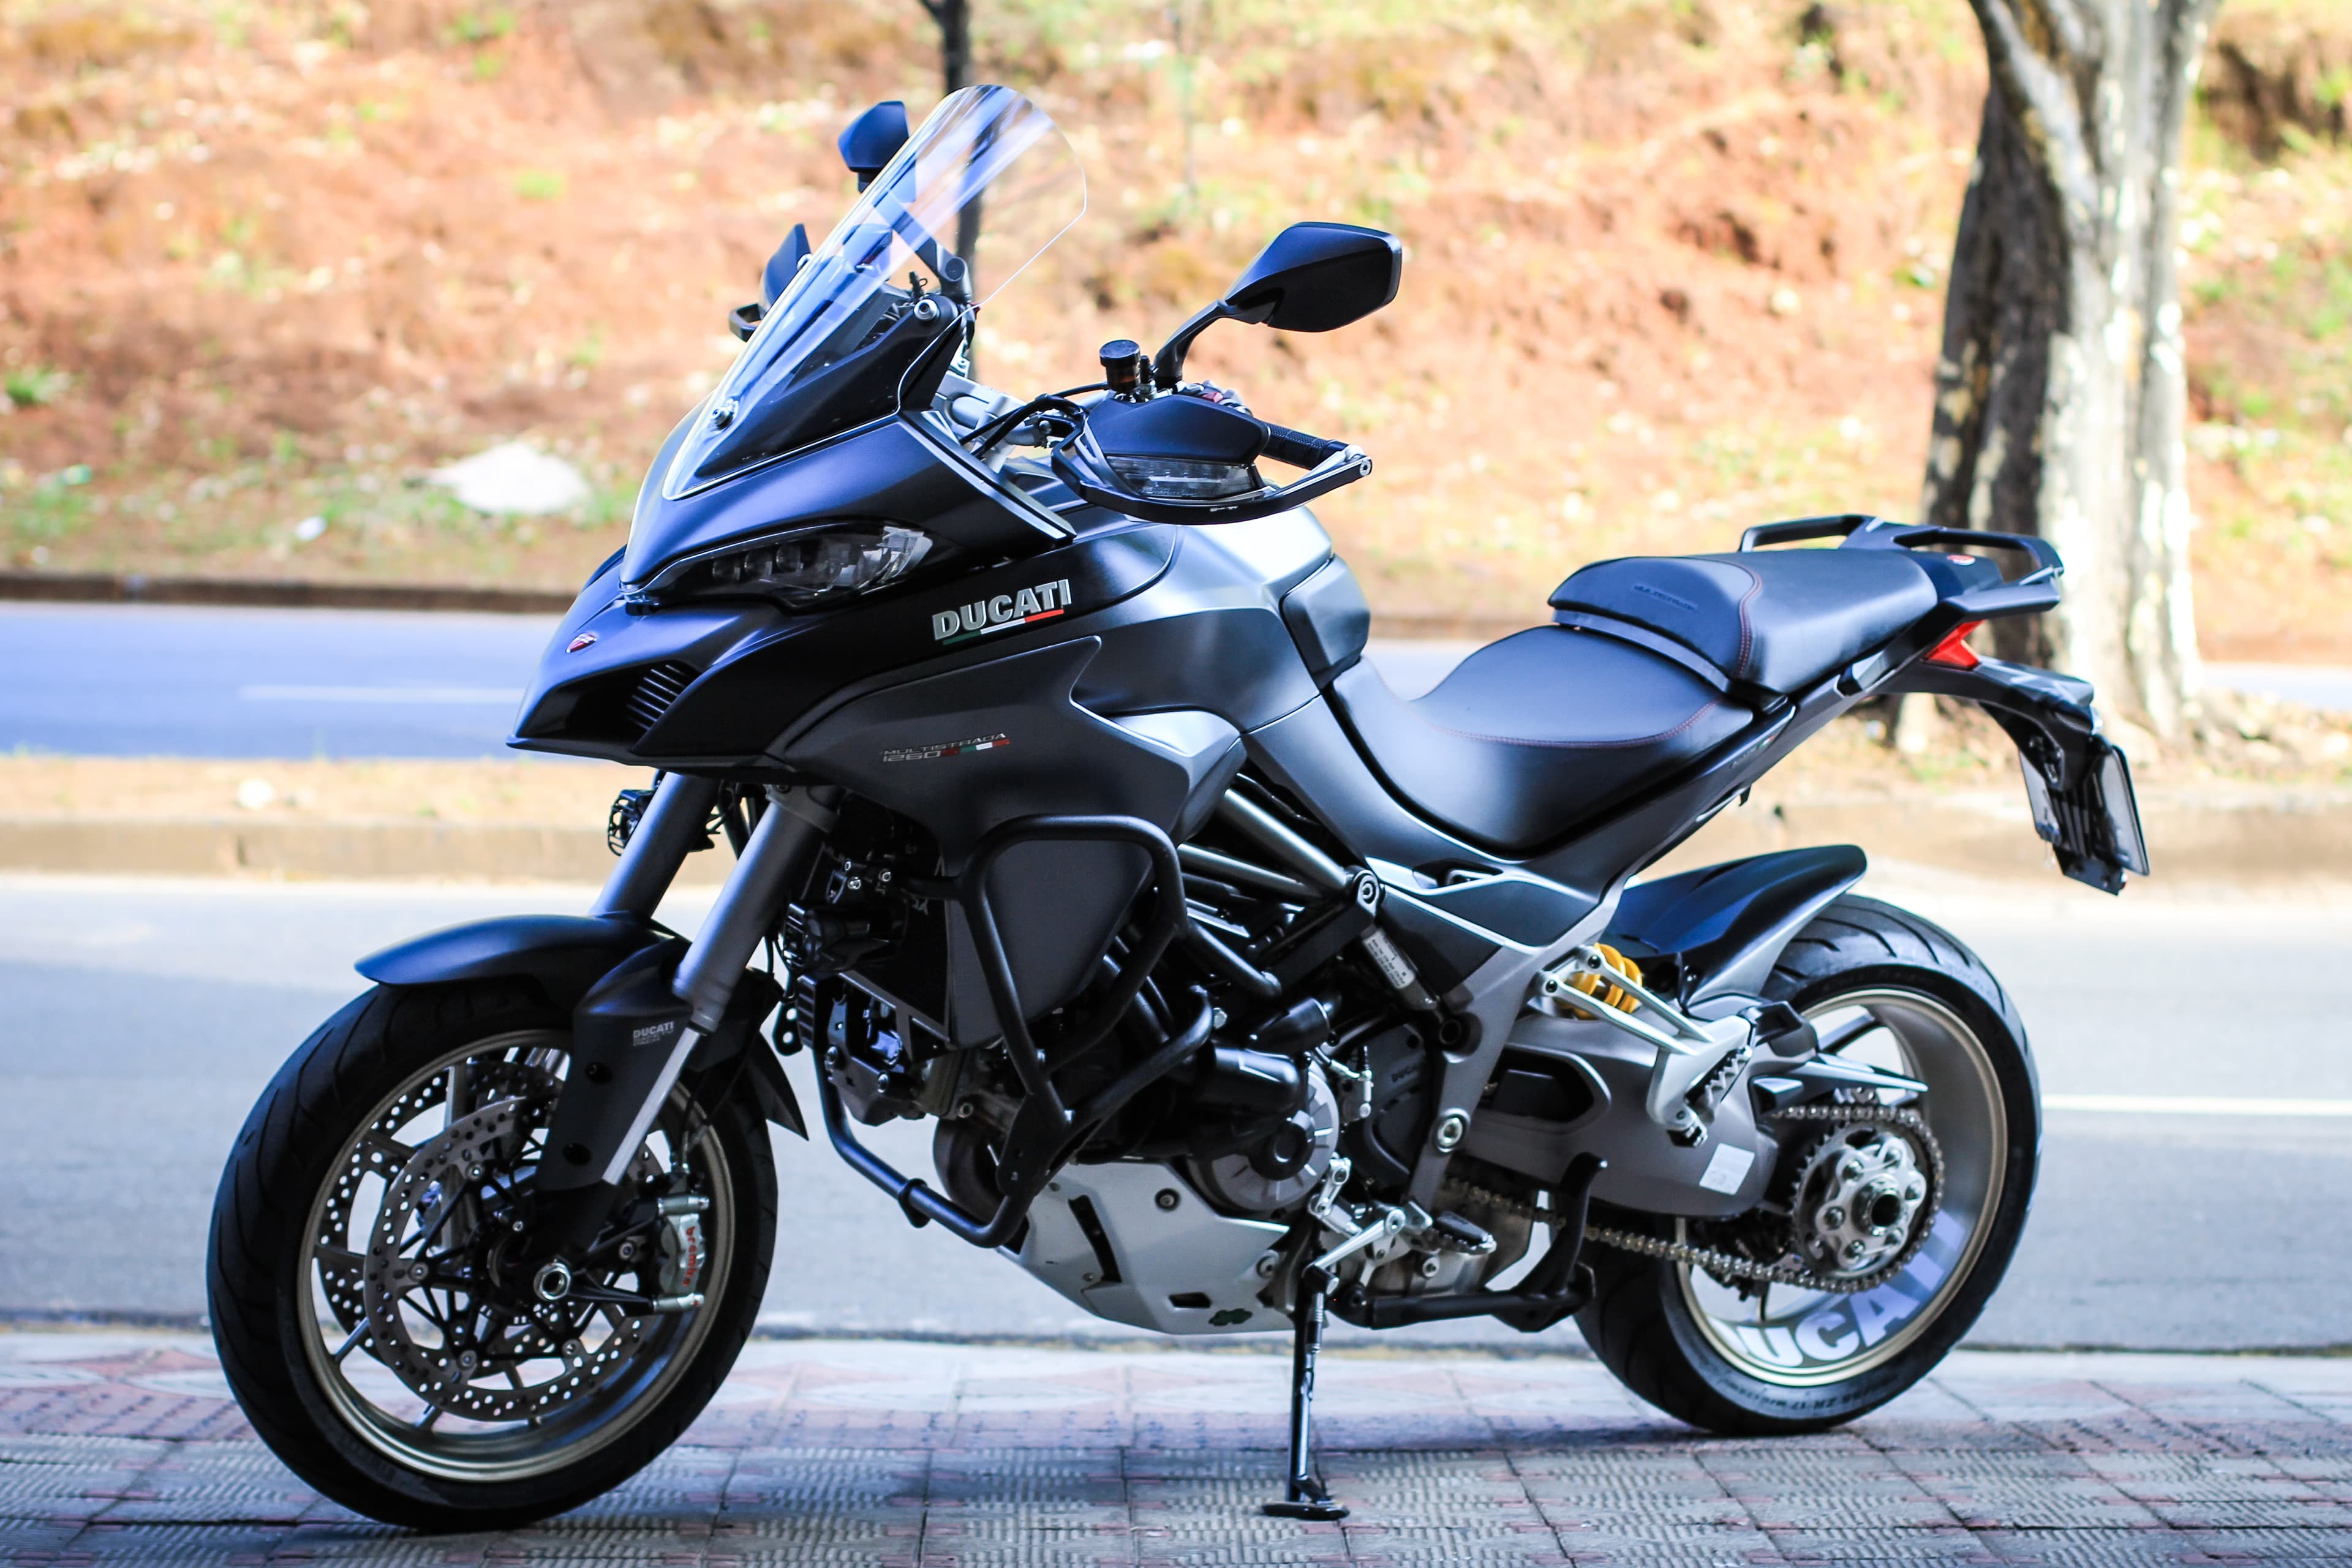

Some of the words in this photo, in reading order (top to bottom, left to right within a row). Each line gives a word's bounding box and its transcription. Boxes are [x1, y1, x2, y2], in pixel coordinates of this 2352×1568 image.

[932, 579, 1072, 641] DUCATI
[884, 733, 1006, 755] MULTISTRADA
[633, 1021, 674, 1038] DUCATI
[682, 1226, 696, 1287] brembo
